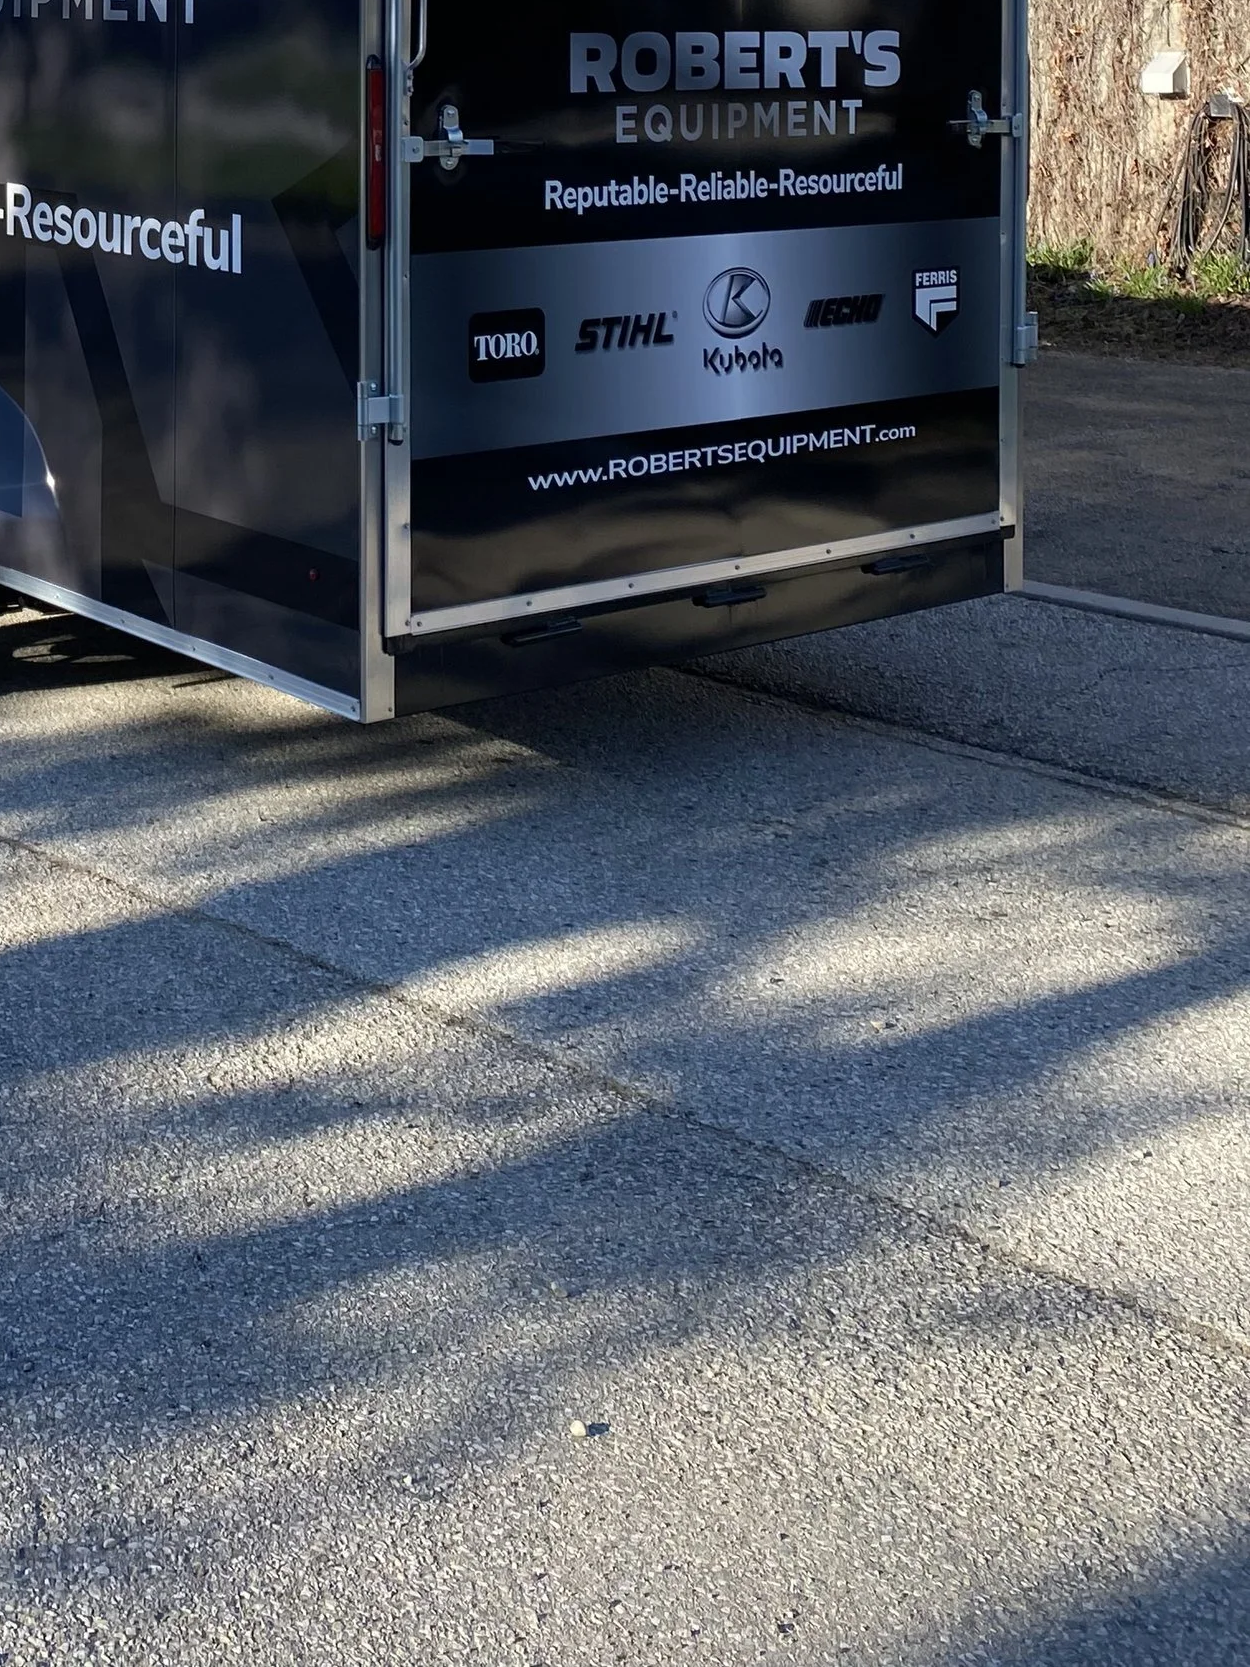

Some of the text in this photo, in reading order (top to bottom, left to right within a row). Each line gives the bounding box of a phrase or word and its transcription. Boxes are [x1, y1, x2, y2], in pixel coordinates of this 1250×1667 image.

[570, 30, 901, 93] ROBERT'S
[616, 99, 863, 144] EQUIPMENT
[545, 163, 903, 215] Reputable-Reliable-Resourceful
[915, 269, 957, 287] FERRIS
[575, 311, 675, 352] STIHL
[703, 342, 783, 374] Kubota
[528, 424, 916, 491] www.ROBERTSEQUIPMENT.com
